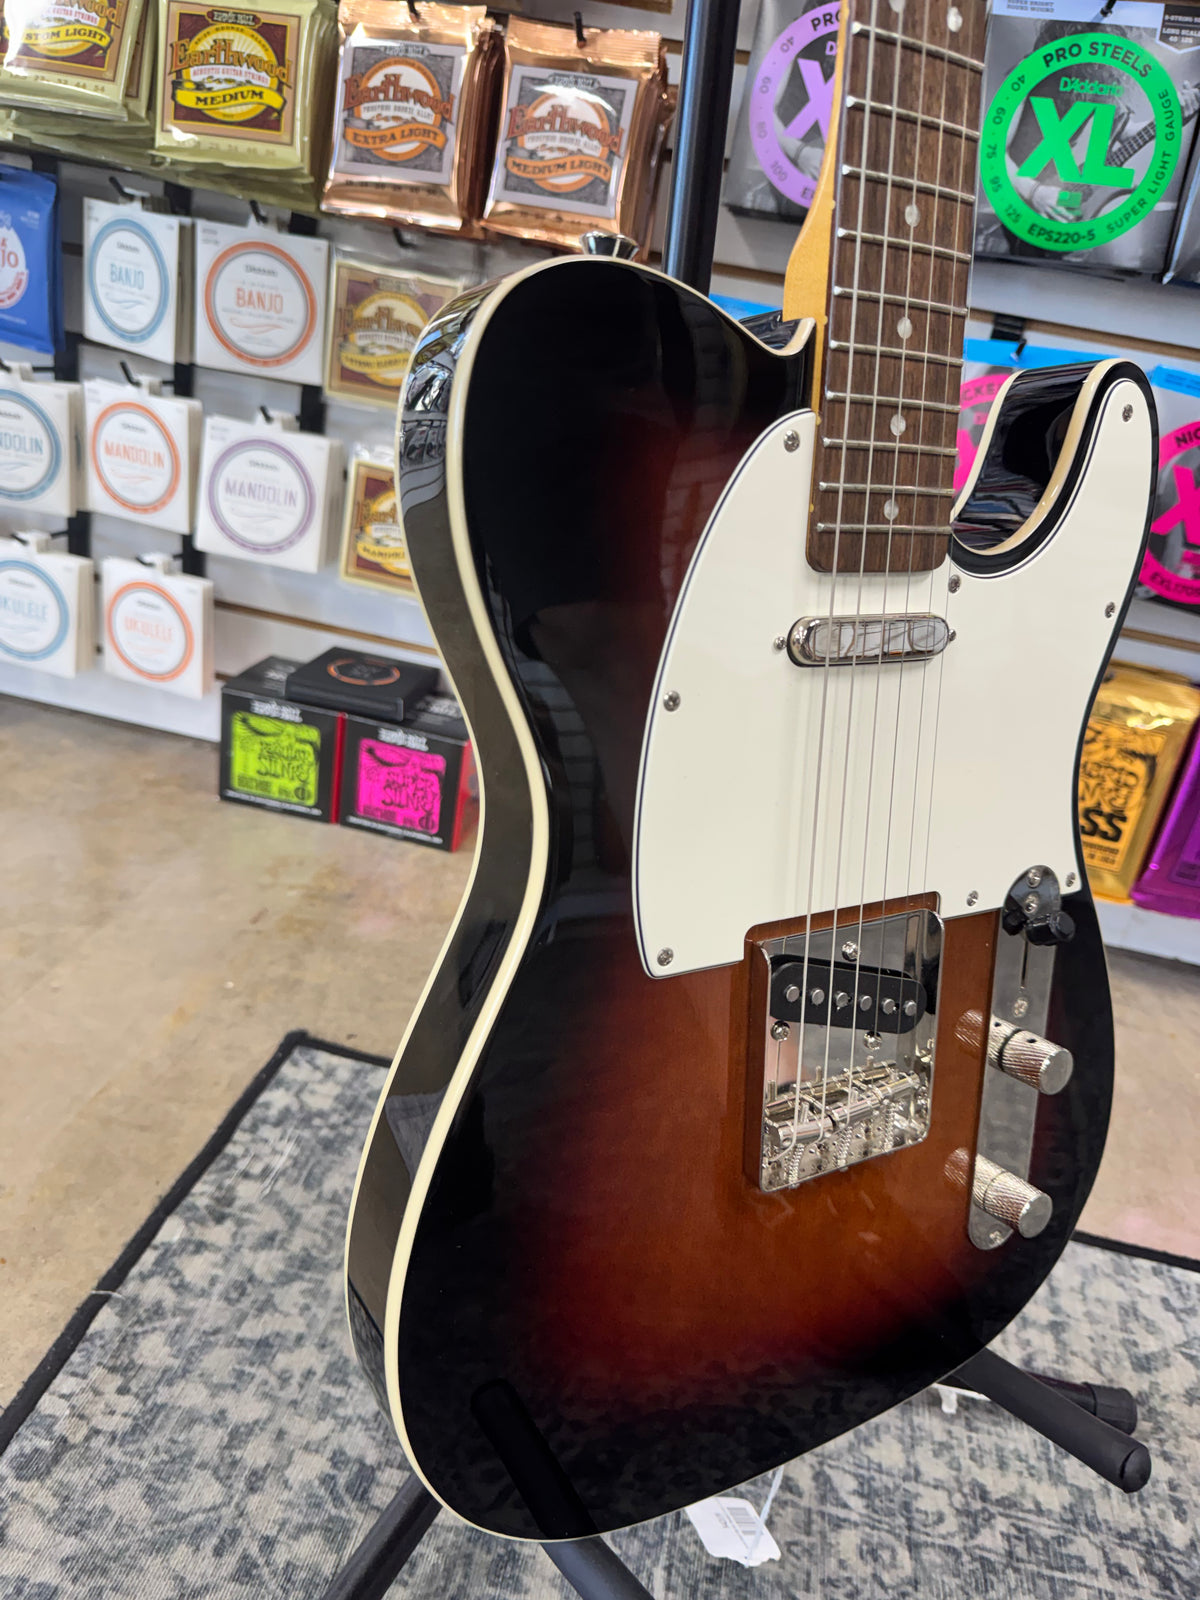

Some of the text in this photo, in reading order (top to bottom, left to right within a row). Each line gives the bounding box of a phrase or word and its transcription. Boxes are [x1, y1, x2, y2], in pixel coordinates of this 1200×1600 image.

[65, 28, 106, 42] LIGHT
[780, 36, 795, 53] 40
[168, 38, 292, 89] Earthwood
[1042, 41, 1153, 78] PRO STEELS
[759, 76, 772, 95] 60
[1011, 74, 1026, 92] 40
[1059, 76, 1125, 98] D'Addario
[195, 89, 264, 106] MEDIUM
[343, 72, 456, 126] Earthwood
[992, 107, 1007, 125] 60
[352, 127, 440, 146] EXTRA LIGHT
[506, 104, 625, 158] Earthwood
[1016, 95, 1136, 189] XL
[985, 143, 998, 160] 75
[1106, 88, 1176, 235] SUPER LIGHT GAUGE
[511, 158, 610, 176] MEDIUM LIGHT
[770, 161, 788, 182] 100
[1004, 203, 1023, 225] 125
[1027, 222, 1097, 246] EPS220-5
[110, 263, 145, 291] BANJO
[236, 287, 284, 315] BANJO
[104, 440, 165, 469] MANDOLIN
[225, 477, 298, 508] MANDOLIN
[1080, 807, 1128, 843] SS
